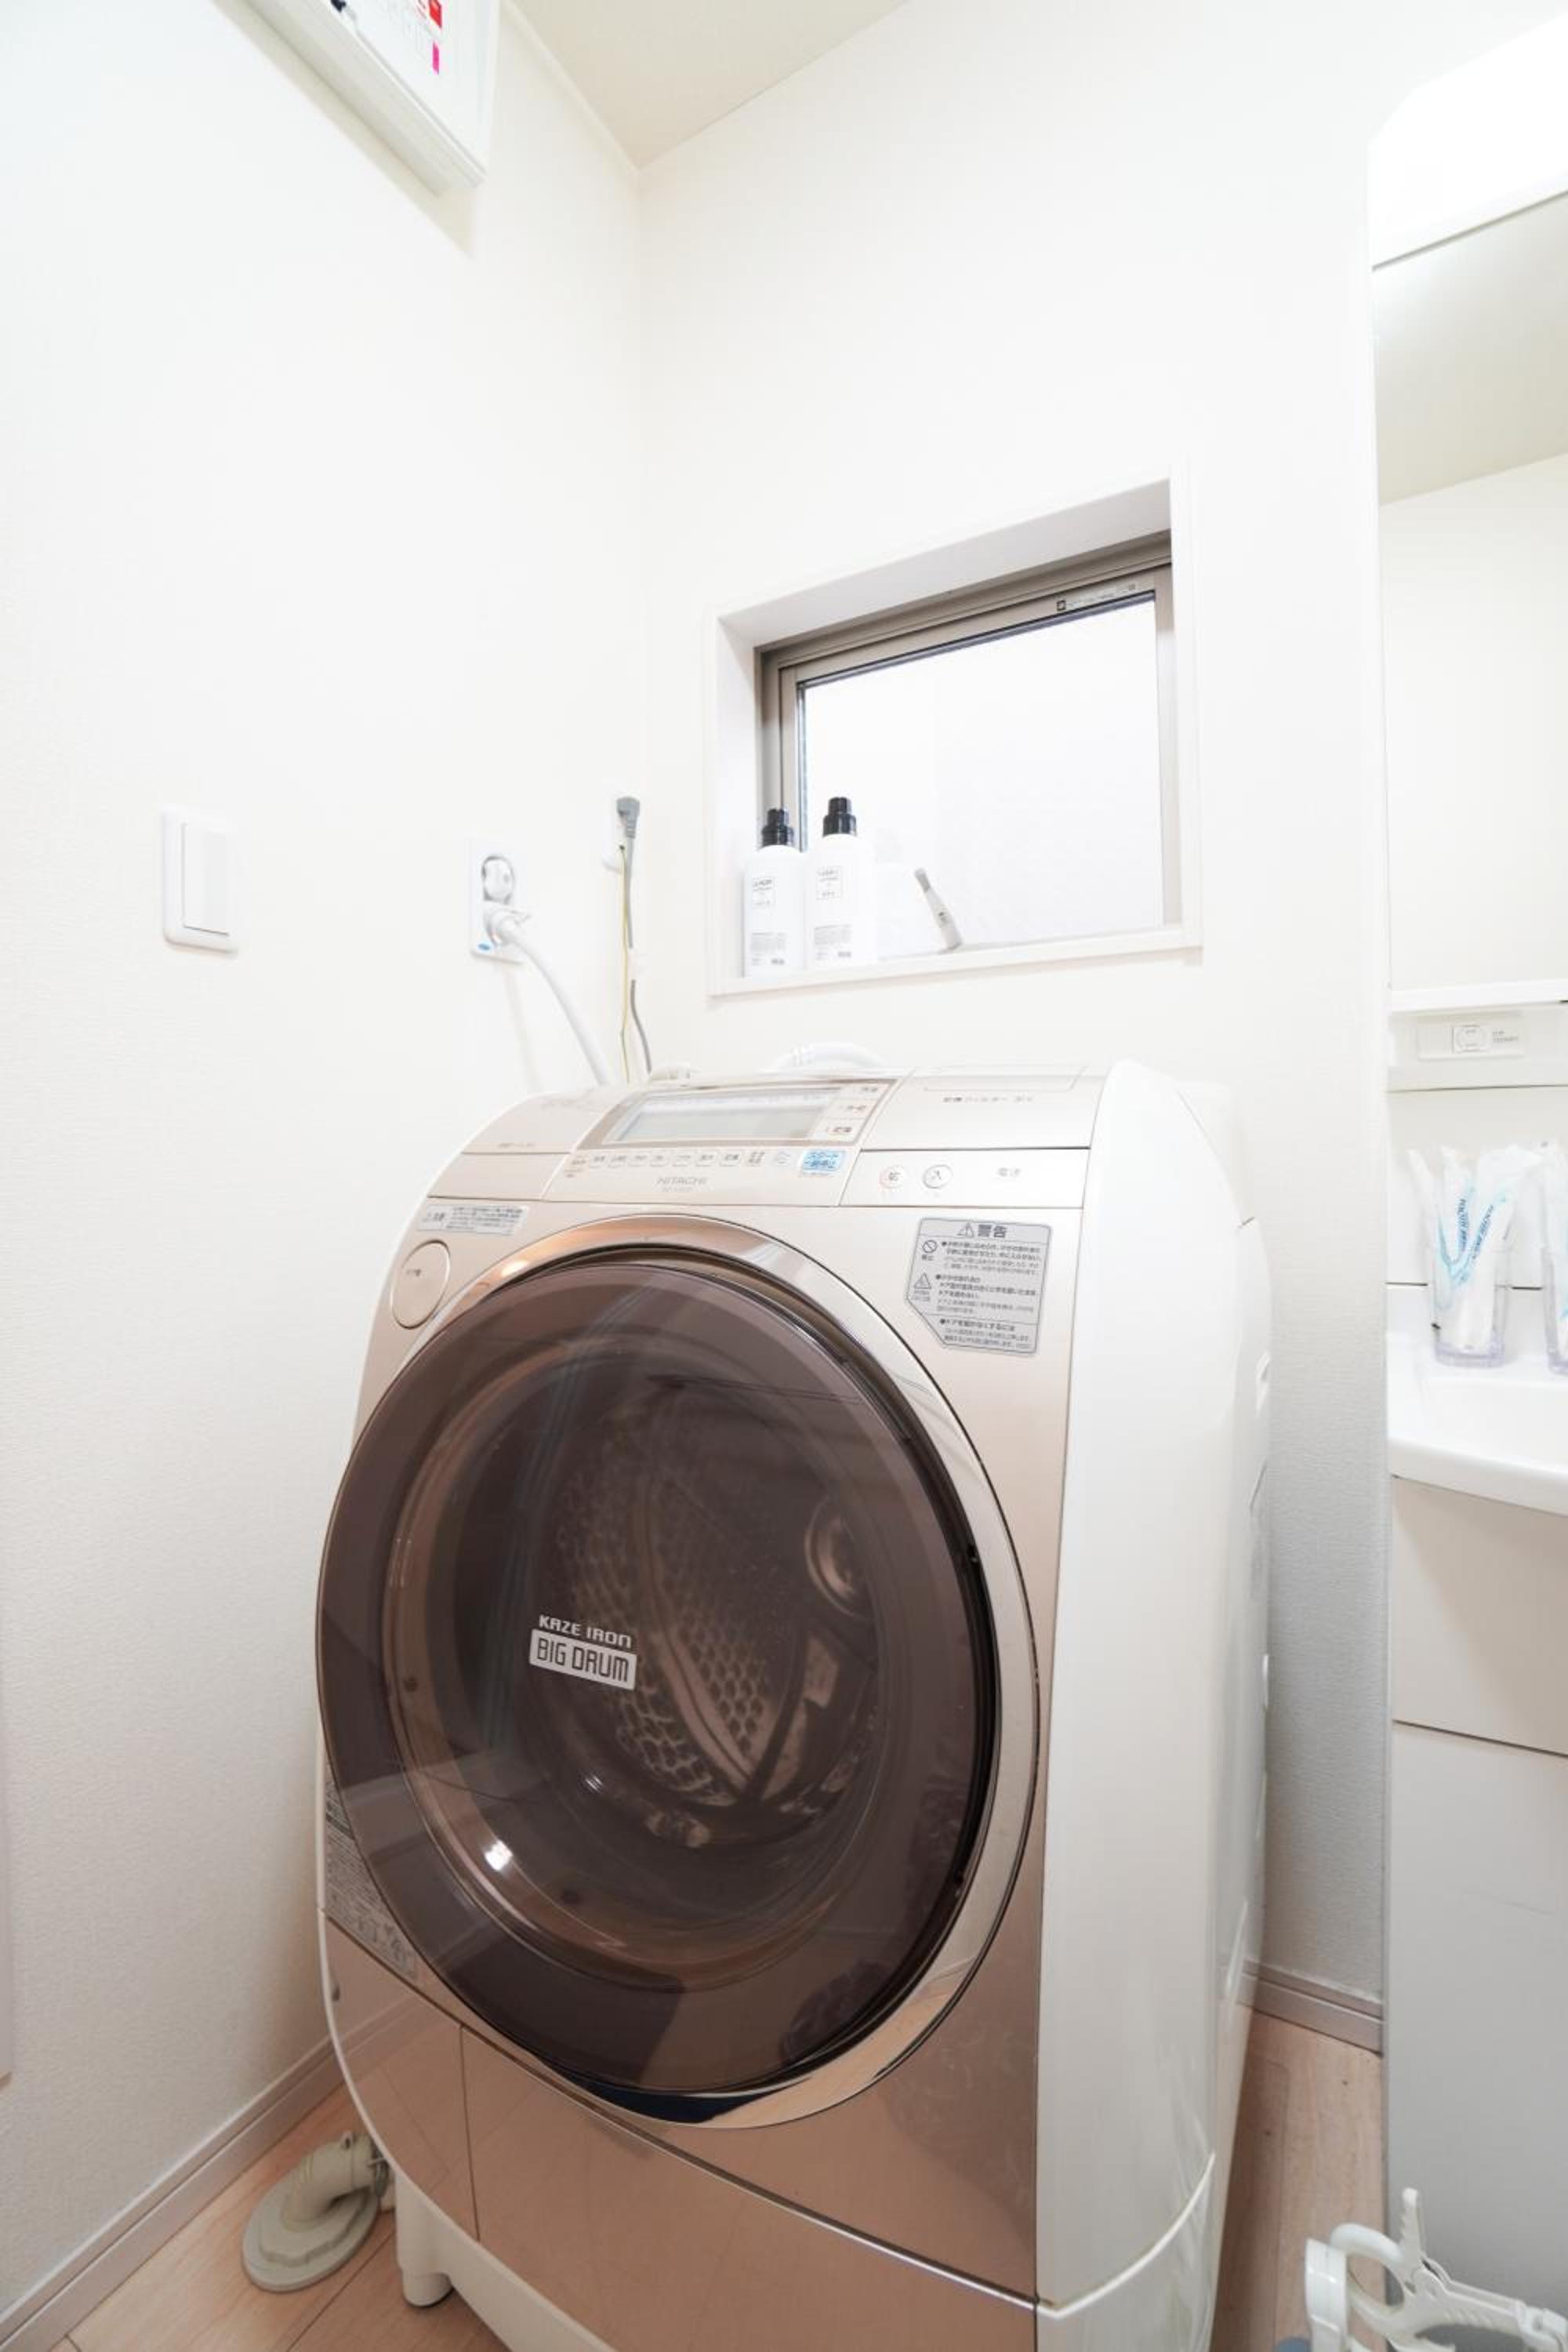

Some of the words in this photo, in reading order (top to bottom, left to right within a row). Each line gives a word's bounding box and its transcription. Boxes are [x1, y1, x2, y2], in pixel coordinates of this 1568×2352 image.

[656, 1176, 708, 1186] HITACHI
[978, 1224, 1008, 1239] 警告
[538, 1614, 581, 1636] KAZE
[586, 1626, 632, 1649] IRON
[537, 1637, 566, 1666] BIG
[572, 1646, 630, 1682] DRUM
